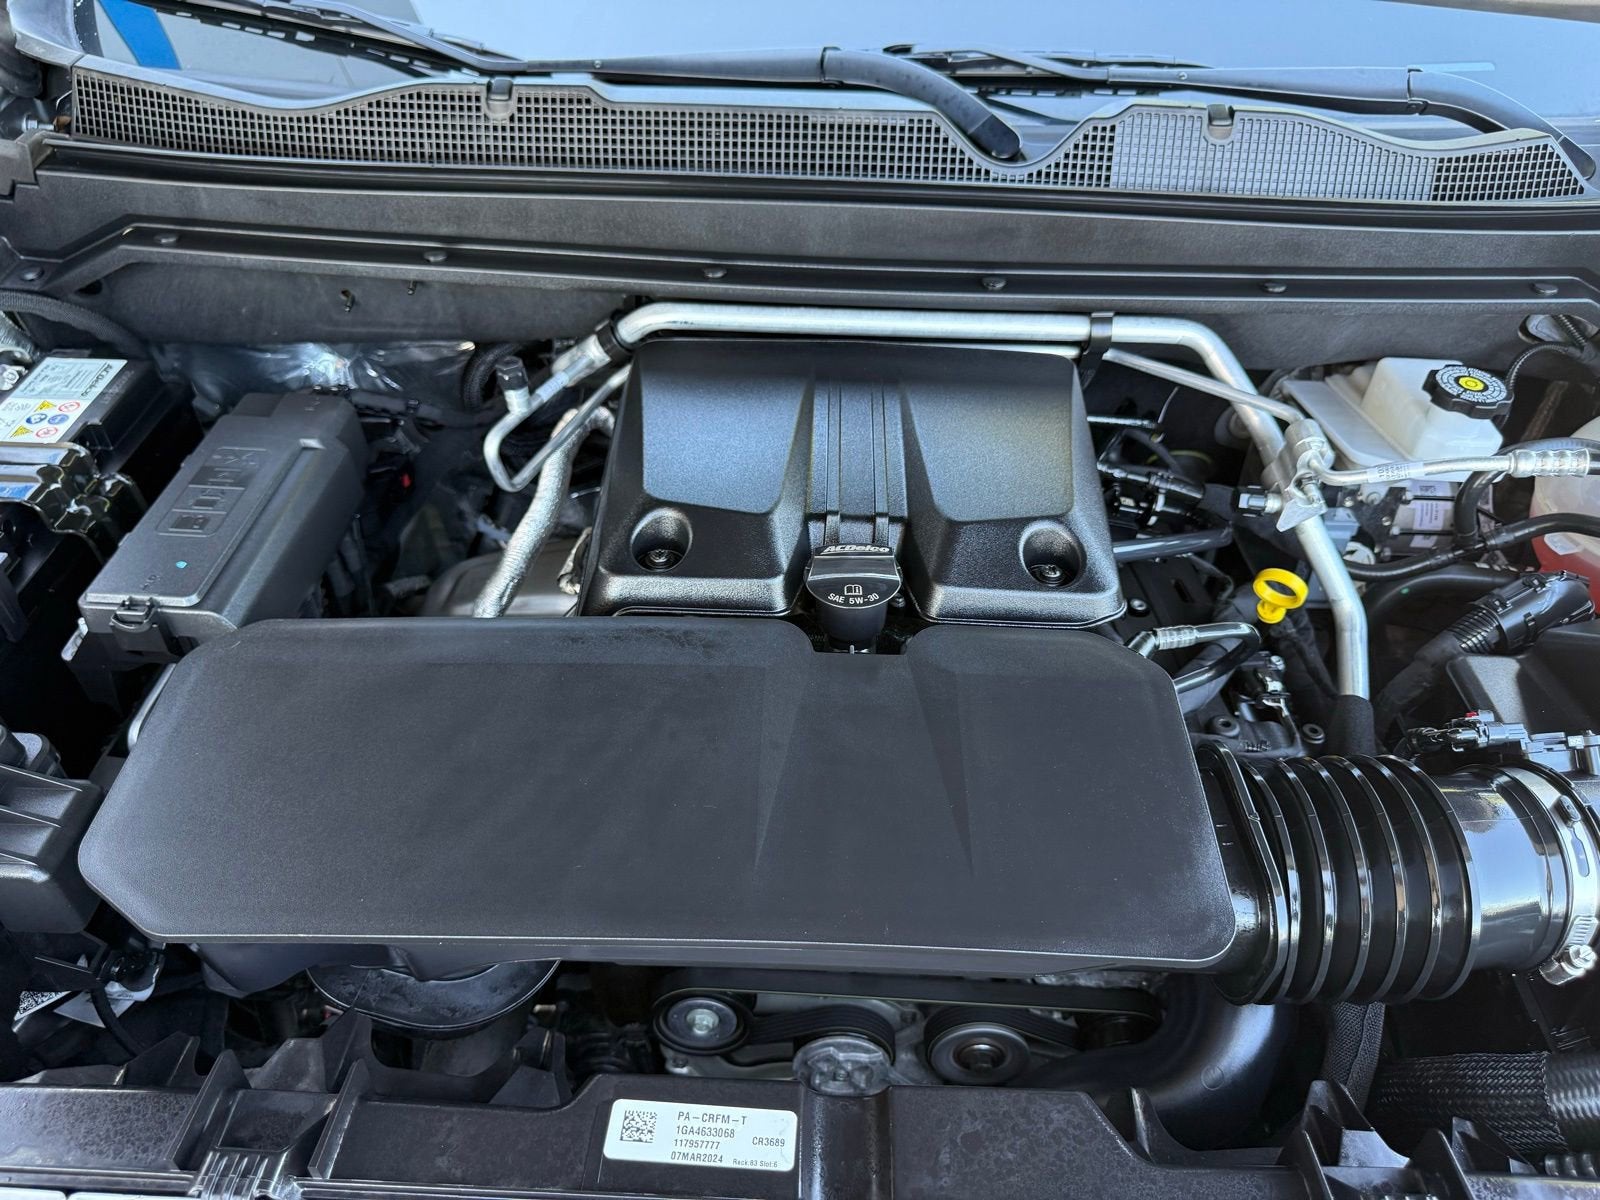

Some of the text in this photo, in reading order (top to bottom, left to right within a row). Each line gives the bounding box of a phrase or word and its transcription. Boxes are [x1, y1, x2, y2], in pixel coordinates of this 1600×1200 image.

[821, 545, 890, 555] ACDelco
[828, 593, 880, 605] SAE 5W-30
[676, 1125, 736, 1139] 1GA4633068
[674, 1138, 721, 1150] 117957777
[752, 1136, 786, 1148] CR3689
[670, 1150, 724, 1164] 07MAR2024
